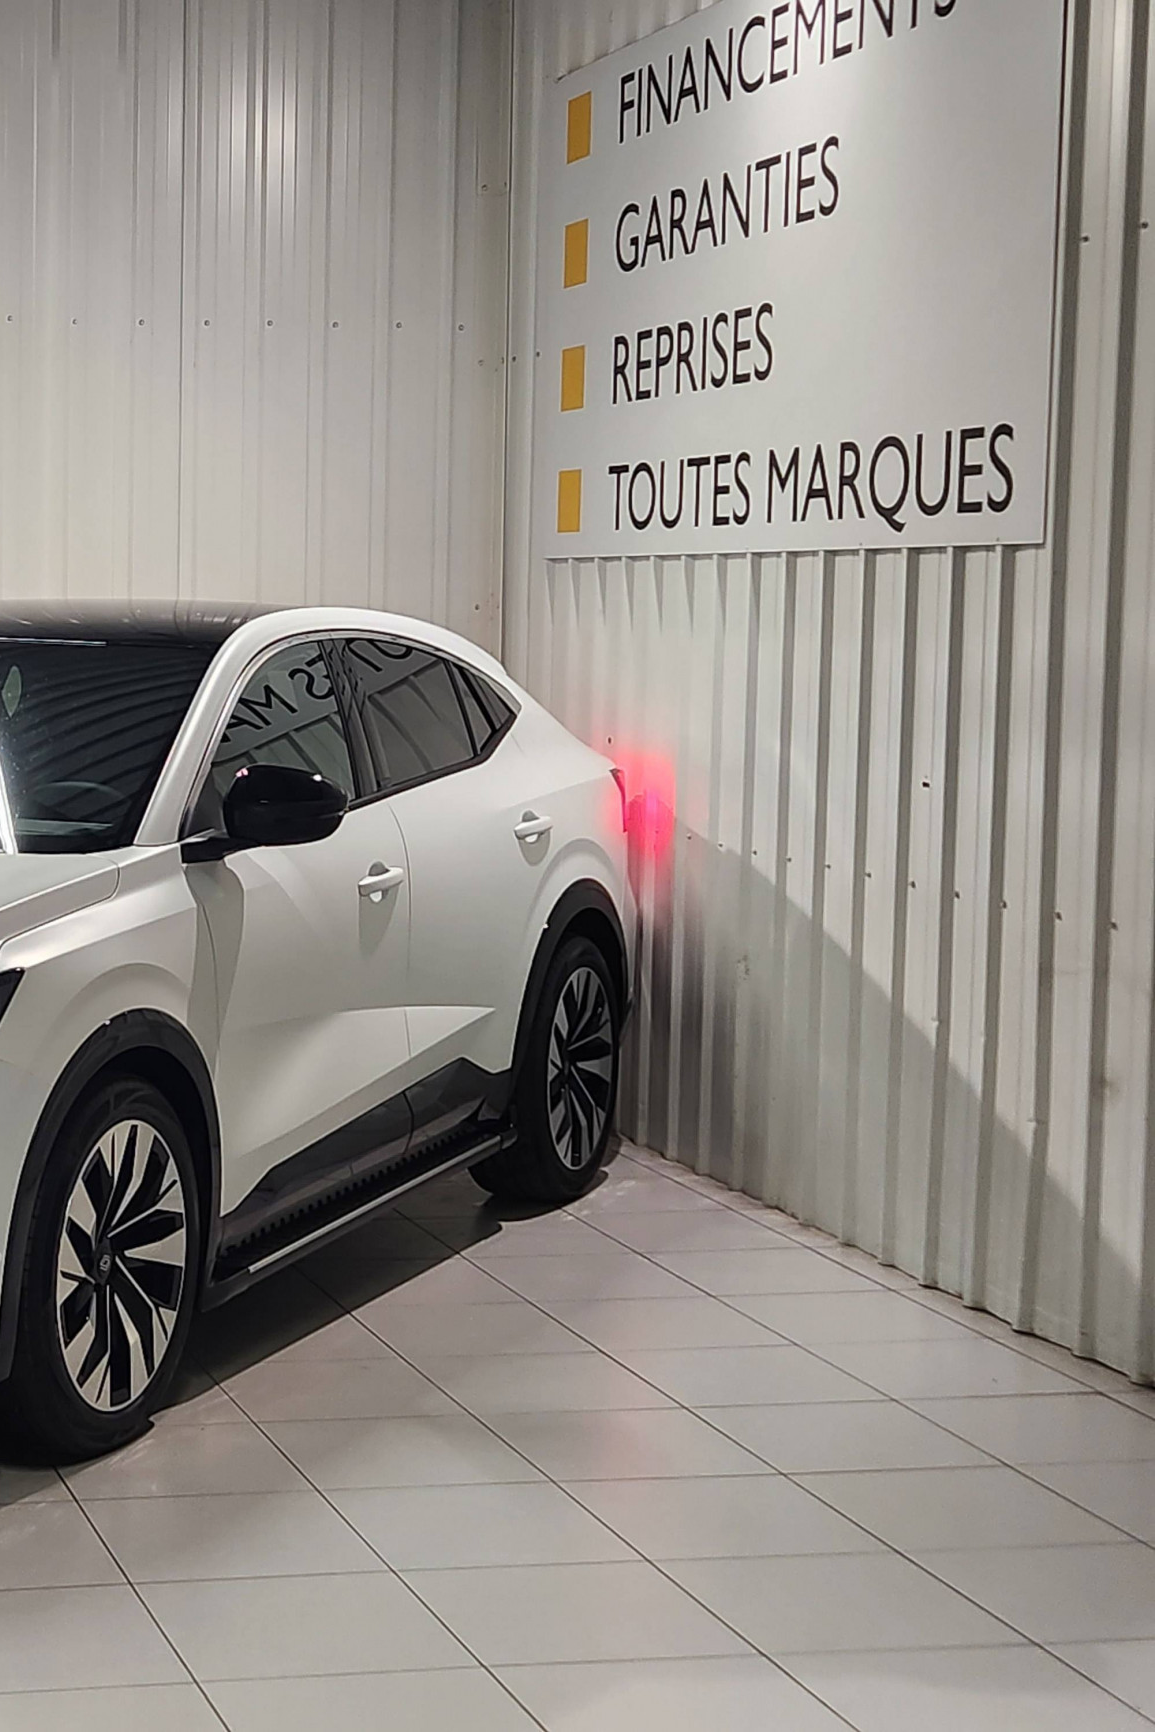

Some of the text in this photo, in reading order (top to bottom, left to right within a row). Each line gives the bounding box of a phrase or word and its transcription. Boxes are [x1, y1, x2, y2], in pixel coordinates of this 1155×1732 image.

[619, 0, 957, 144] FINANCEMEN
[615, 136, 839, 273] GARANTIES
[612, 302, 773, 405] REPRISES
[608, 423, 1014, 533] TOUTES MARQUES
